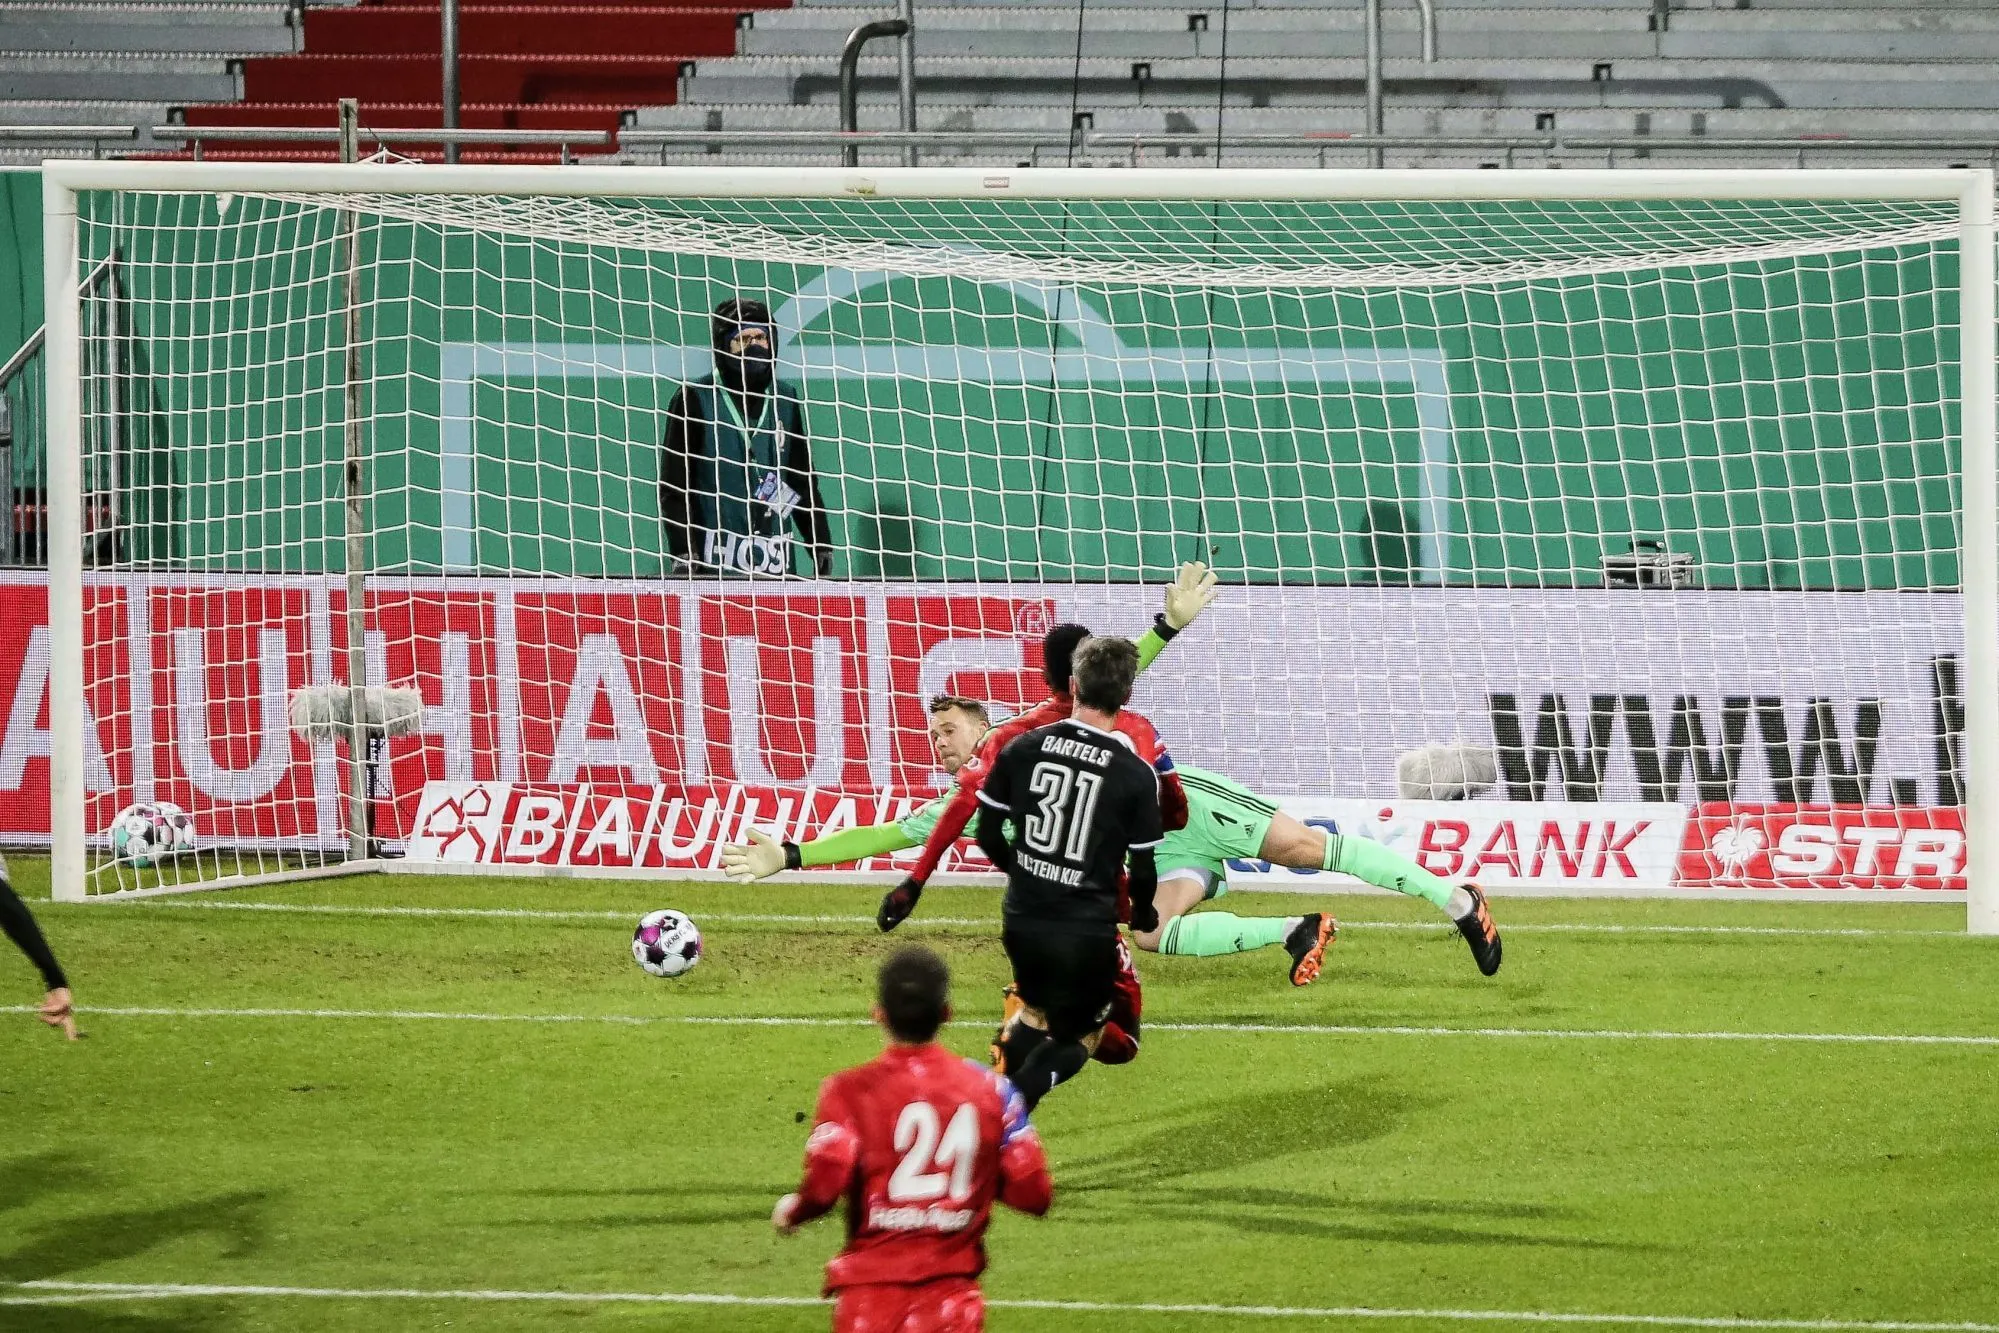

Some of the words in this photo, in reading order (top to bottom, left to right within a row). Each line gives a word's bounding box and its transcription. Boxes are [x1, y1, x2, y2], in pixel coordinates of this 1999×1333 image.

[1040, 735, 1114, 768] BARTELS
[1025, 761, 1103, 862] 31
[1416, 819, 1652, 878] BANK
[1773, 824, 1966, 877] STR
[887, 1101, 981, 1201] 21
